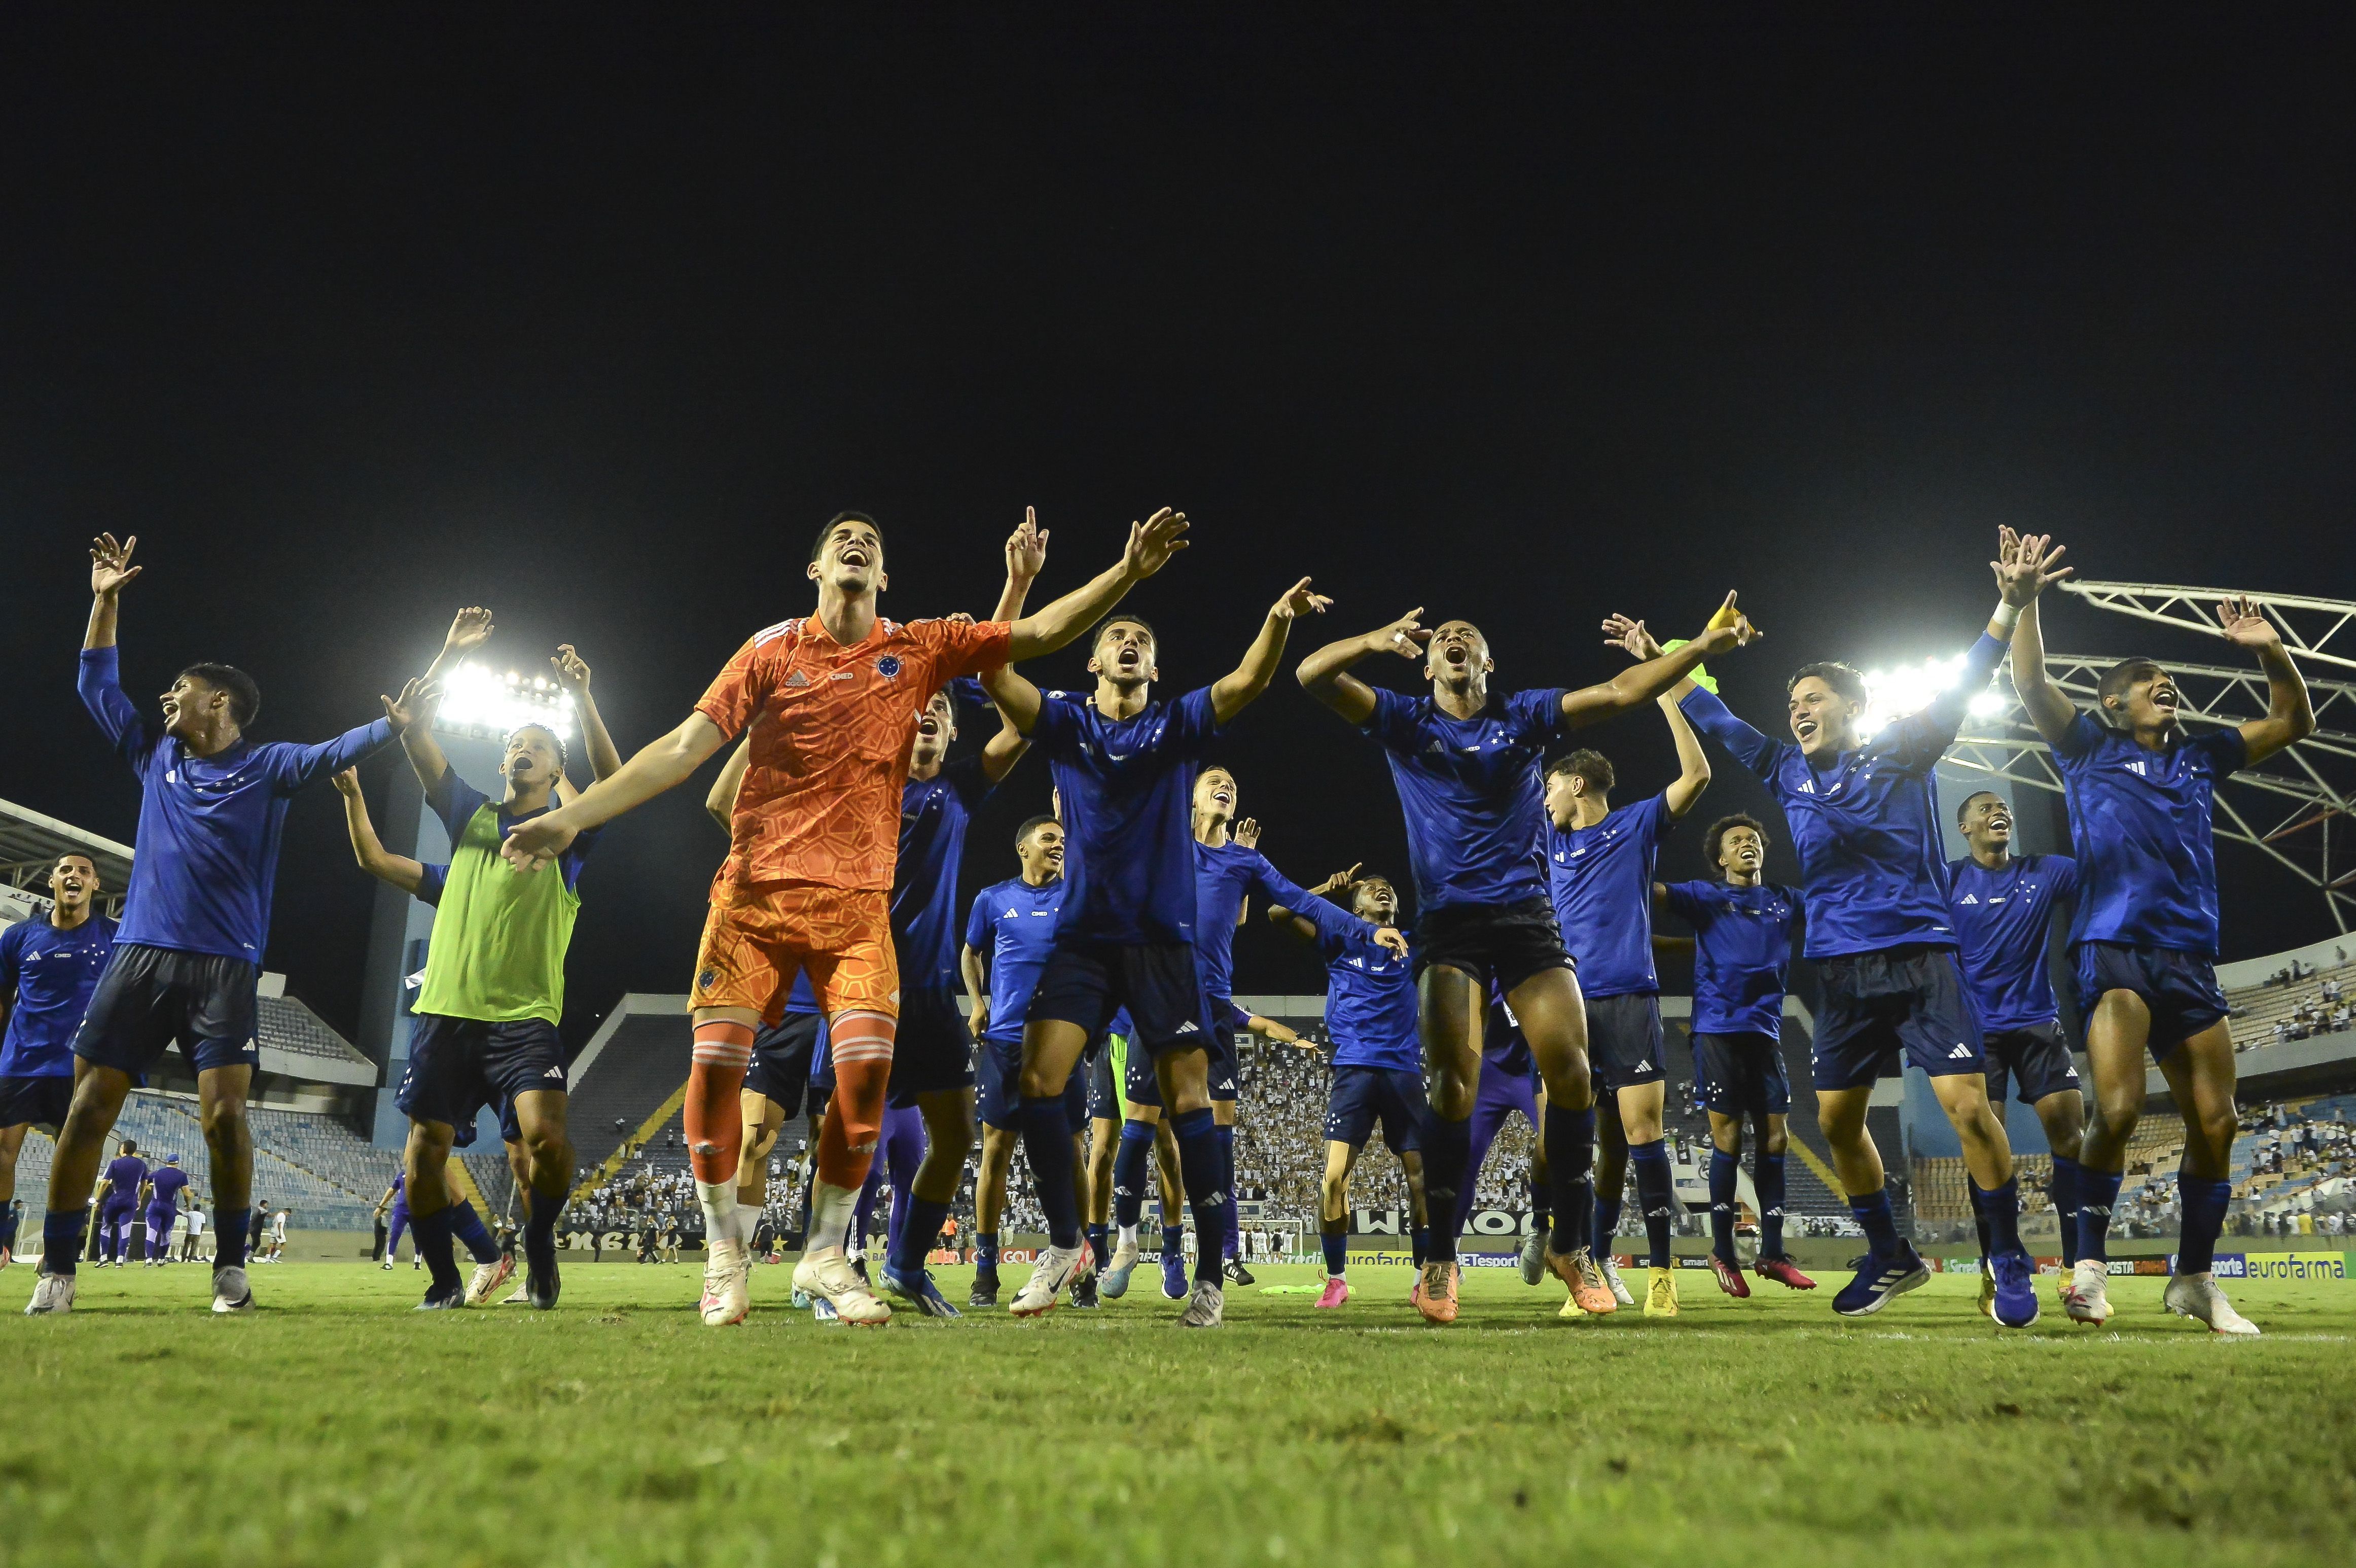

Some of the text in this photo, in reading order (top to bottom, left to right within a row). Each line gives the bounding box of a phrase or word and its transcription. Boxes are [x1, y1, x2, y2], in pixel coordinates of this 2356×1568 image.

[1004, 1250, 1033, 1264] GOL
[1346, 1252, 1413, 1266] urofarm
[2249, 1254, 2345, 1279] eurofarma
